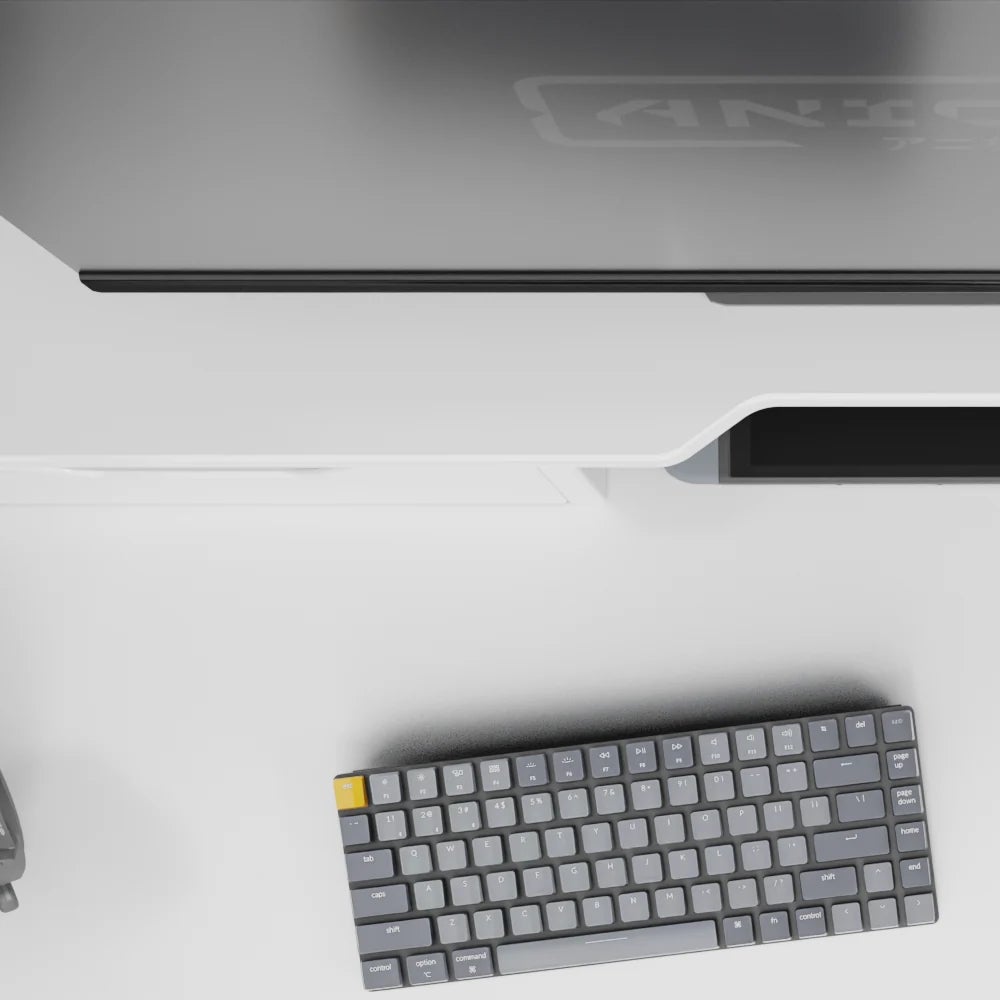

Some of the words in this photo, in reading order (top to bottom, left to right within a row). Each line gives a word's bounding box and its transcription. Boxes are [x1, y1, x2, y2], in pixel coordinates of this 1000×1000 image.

[855, 721, 866, 729] del
[896, 790, 913, 798] page
[897, 797, 917, 806] down
[900, 826, 920, 835] home
[446, 845, 454, 853] W
[411, 849, 418, 858] Q
[908, 863, 921, 871] end
[821, 873, 836, 881] shift
[371, 891, 386, 899] caps
[799, 911, 822, 921] control
[386, 926, 401, 934] shift
[455, 952, 487, 962] command
[415, 958, 437, 968] option
[369, 964, 392, 973] control
